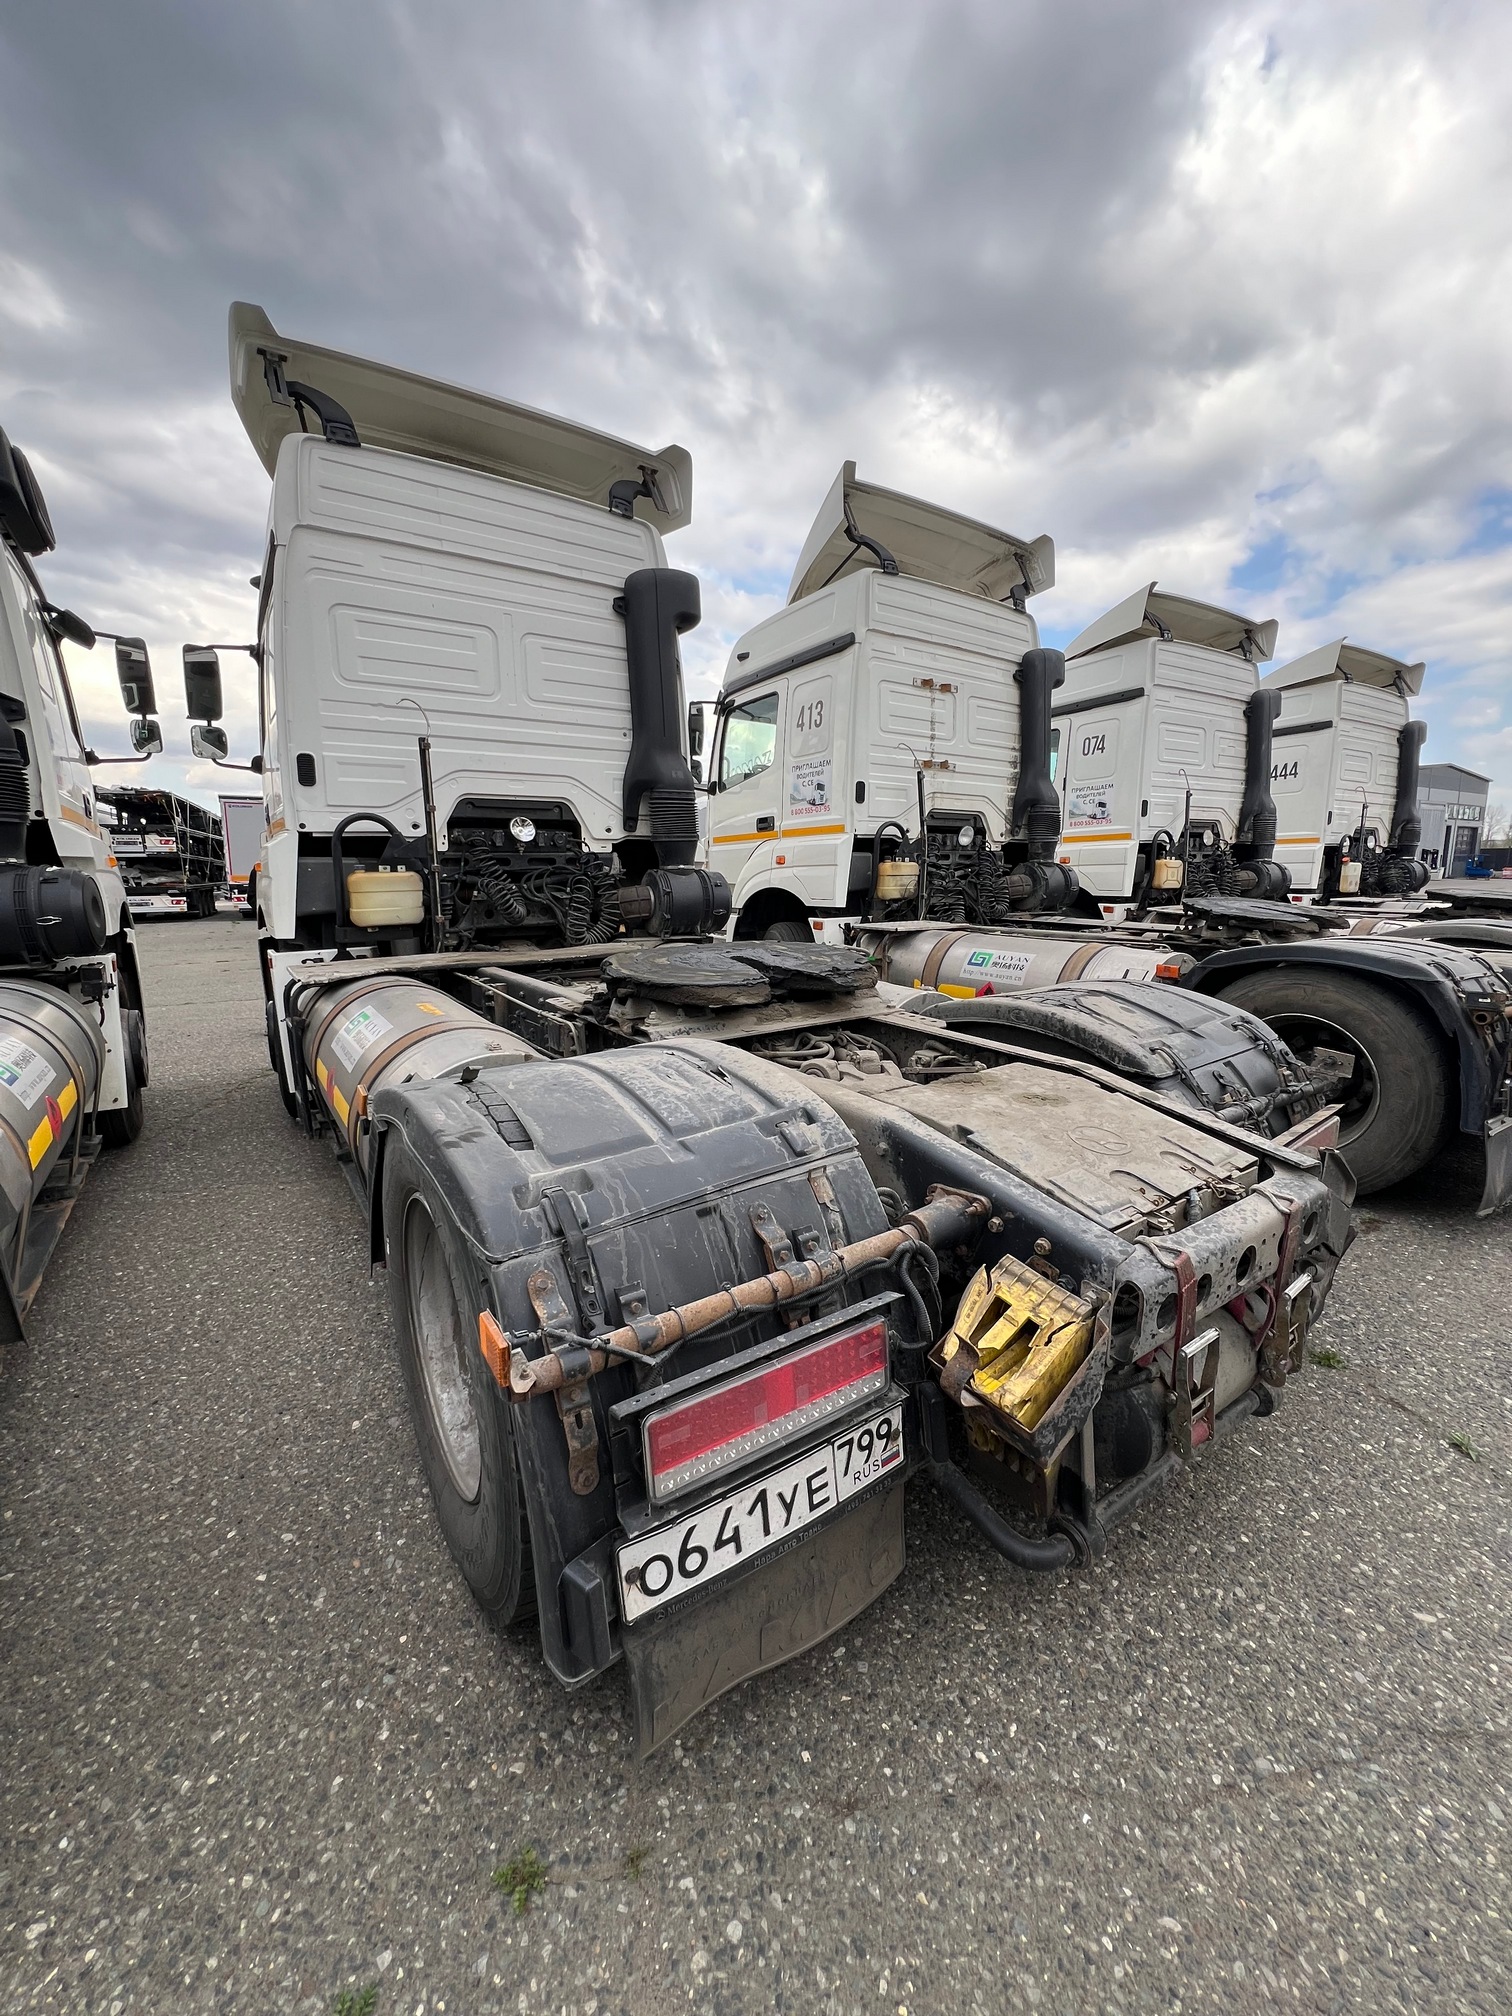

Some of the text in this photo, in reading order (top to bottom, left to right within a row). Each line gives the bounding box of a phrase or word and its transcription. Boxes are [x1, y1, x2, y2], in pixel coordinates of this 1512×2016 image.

[796, 700, 824, 732] 413
[1082, 734, 1106, 757] 074
[791, 759, 832, 773] ПРИГЛАШАЕМ
[796, 768, 825, 780] ВОДИТЕЛЕЙ
[1270, 761, 1299, 781] 444
[1071, 783, 1114, 793] ПРИГЛАШАЕМ
[1076, 790, 1106, 799] ВОДИТЕЛЕЙ
[995, 954, 1031, 963] AUYAN
[853, 1458, 881, 1486] RUS
[640, 1416, 893, 1597] О641УЕ 799
[754, 1550, 777, 1569] Нара
[778, 1538, 798, 1555] Авто
[798, 1523, 823, 1543] Транс
[666, 1578, 728, 1616] Mercedes-Benz
